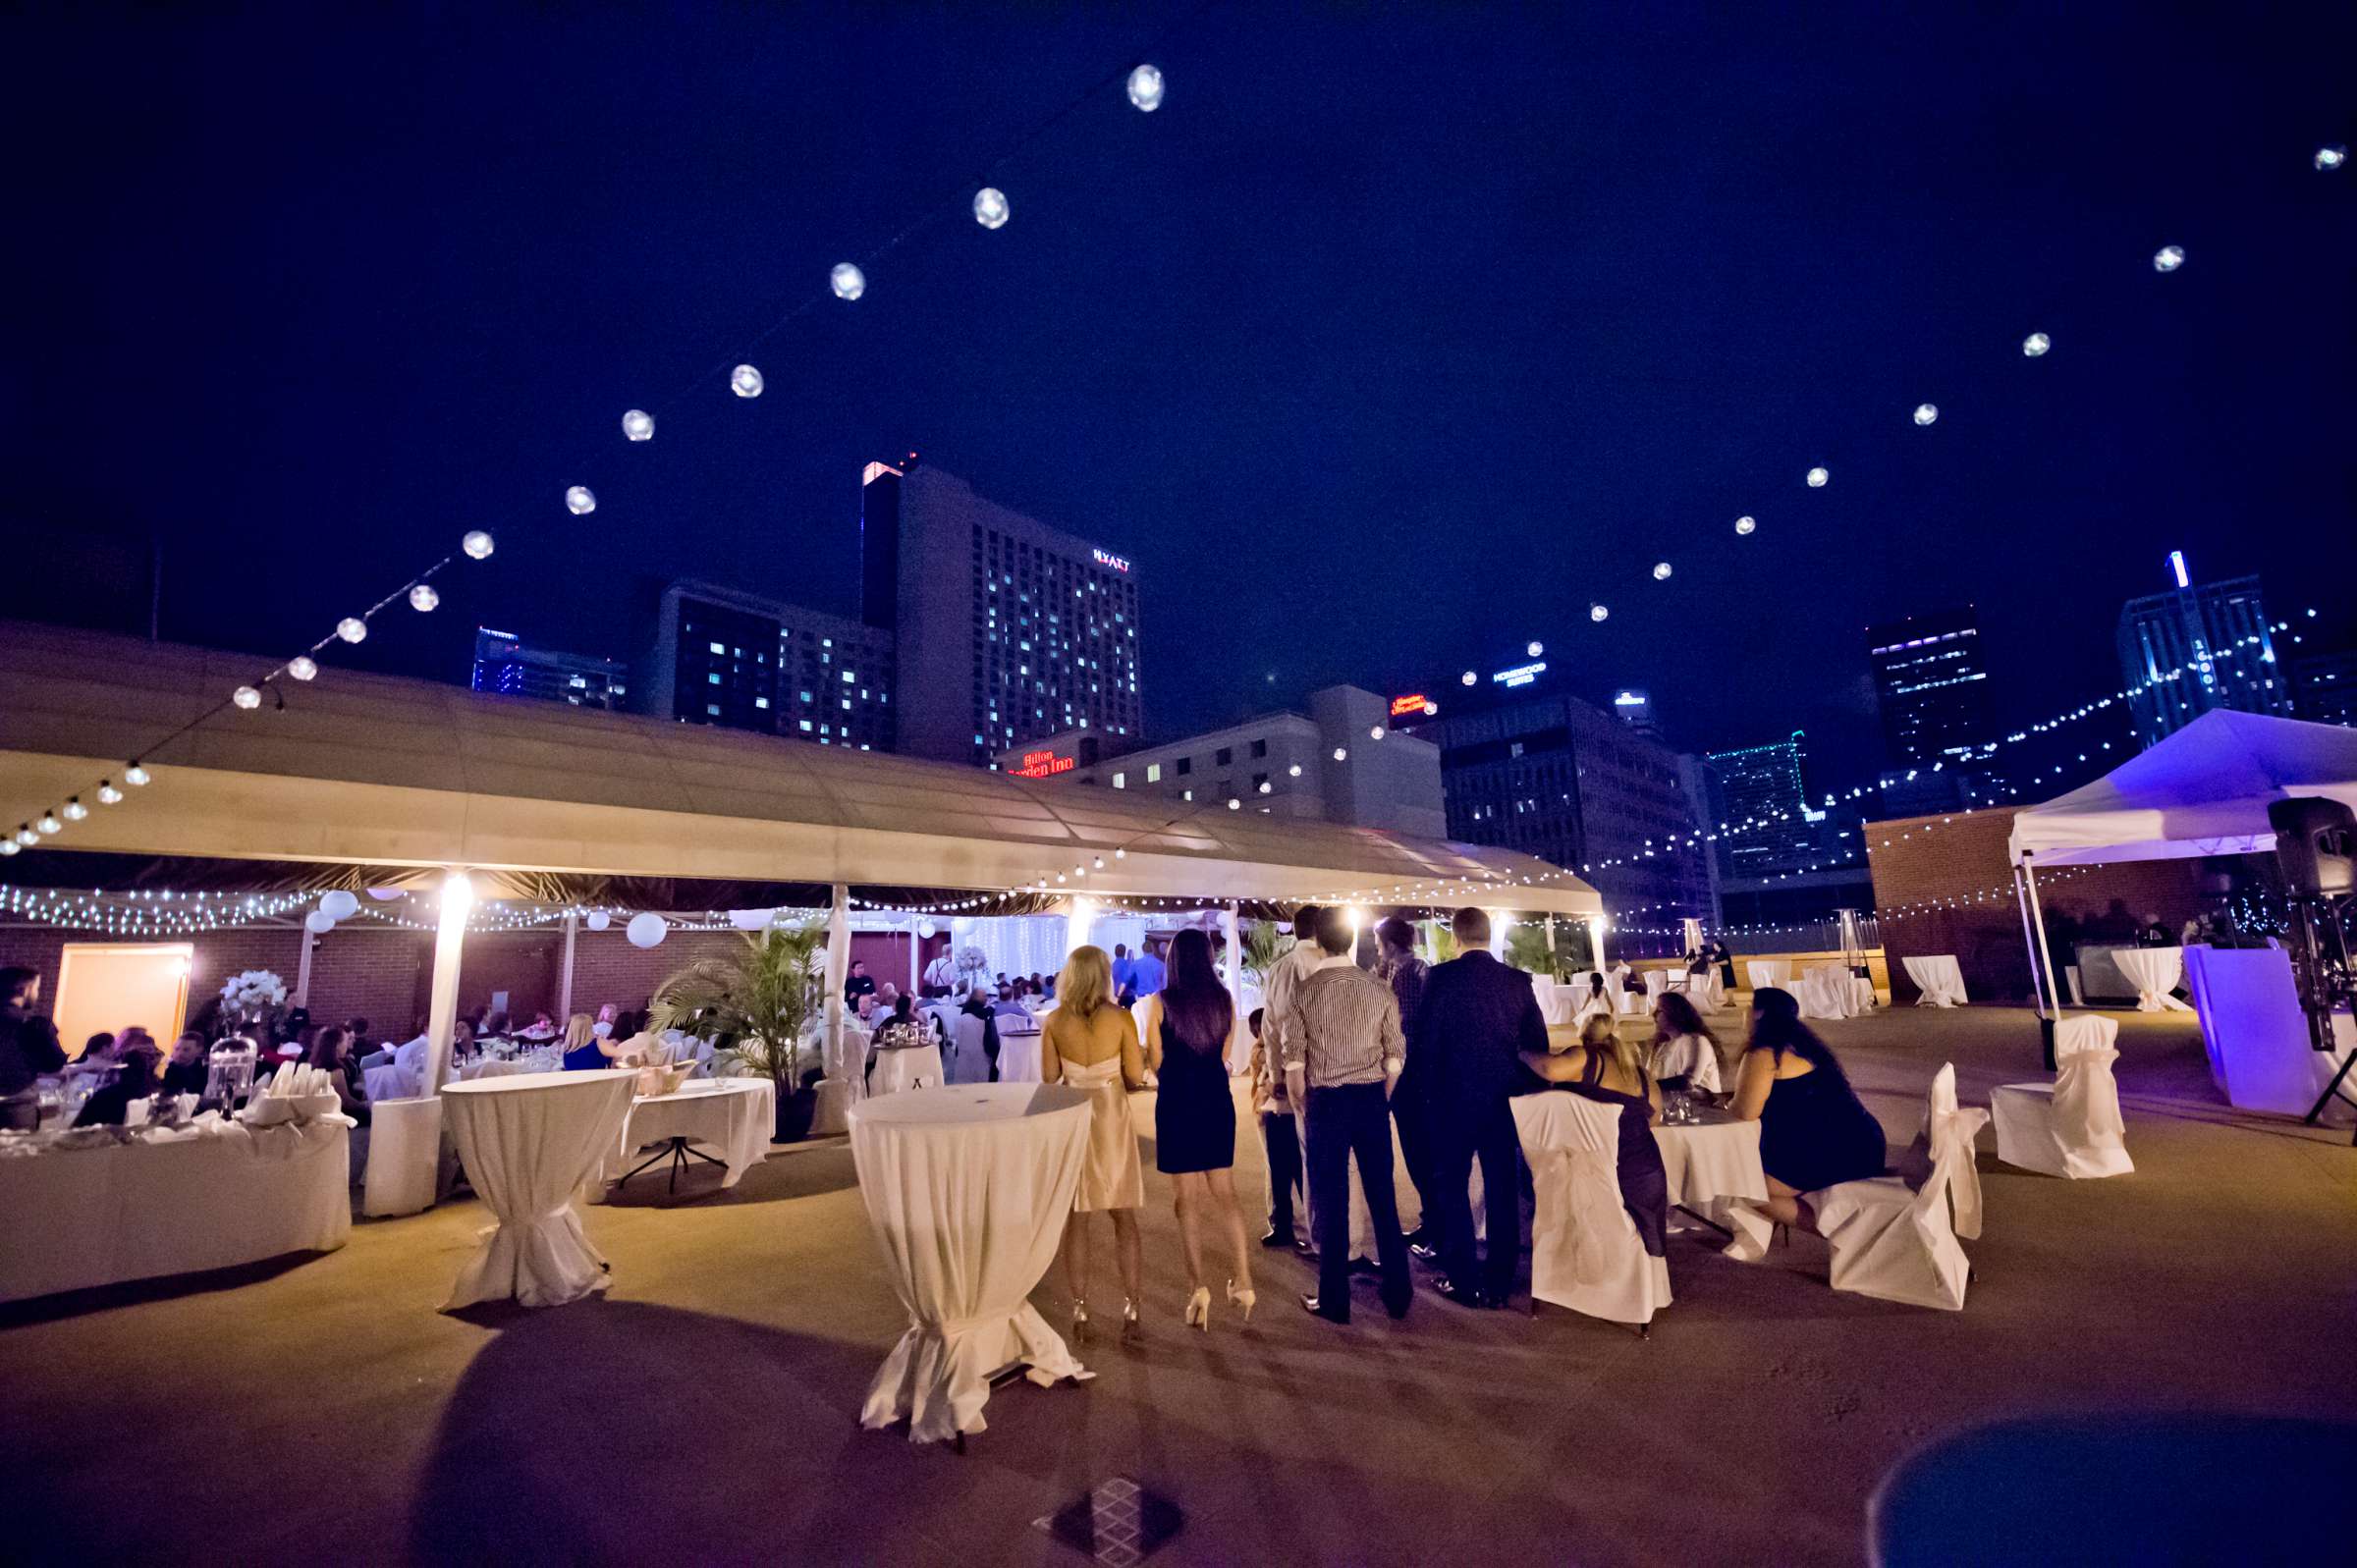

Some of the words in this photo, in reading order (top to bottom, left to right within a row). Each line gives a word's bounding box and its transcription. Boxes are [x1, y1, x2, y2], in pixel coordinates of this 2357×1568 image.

[1093, 549, 1130, 572] HYATT
[1023, 750, 1054, 767] Hilton
[1051, 757, 1074, 774] Inn
